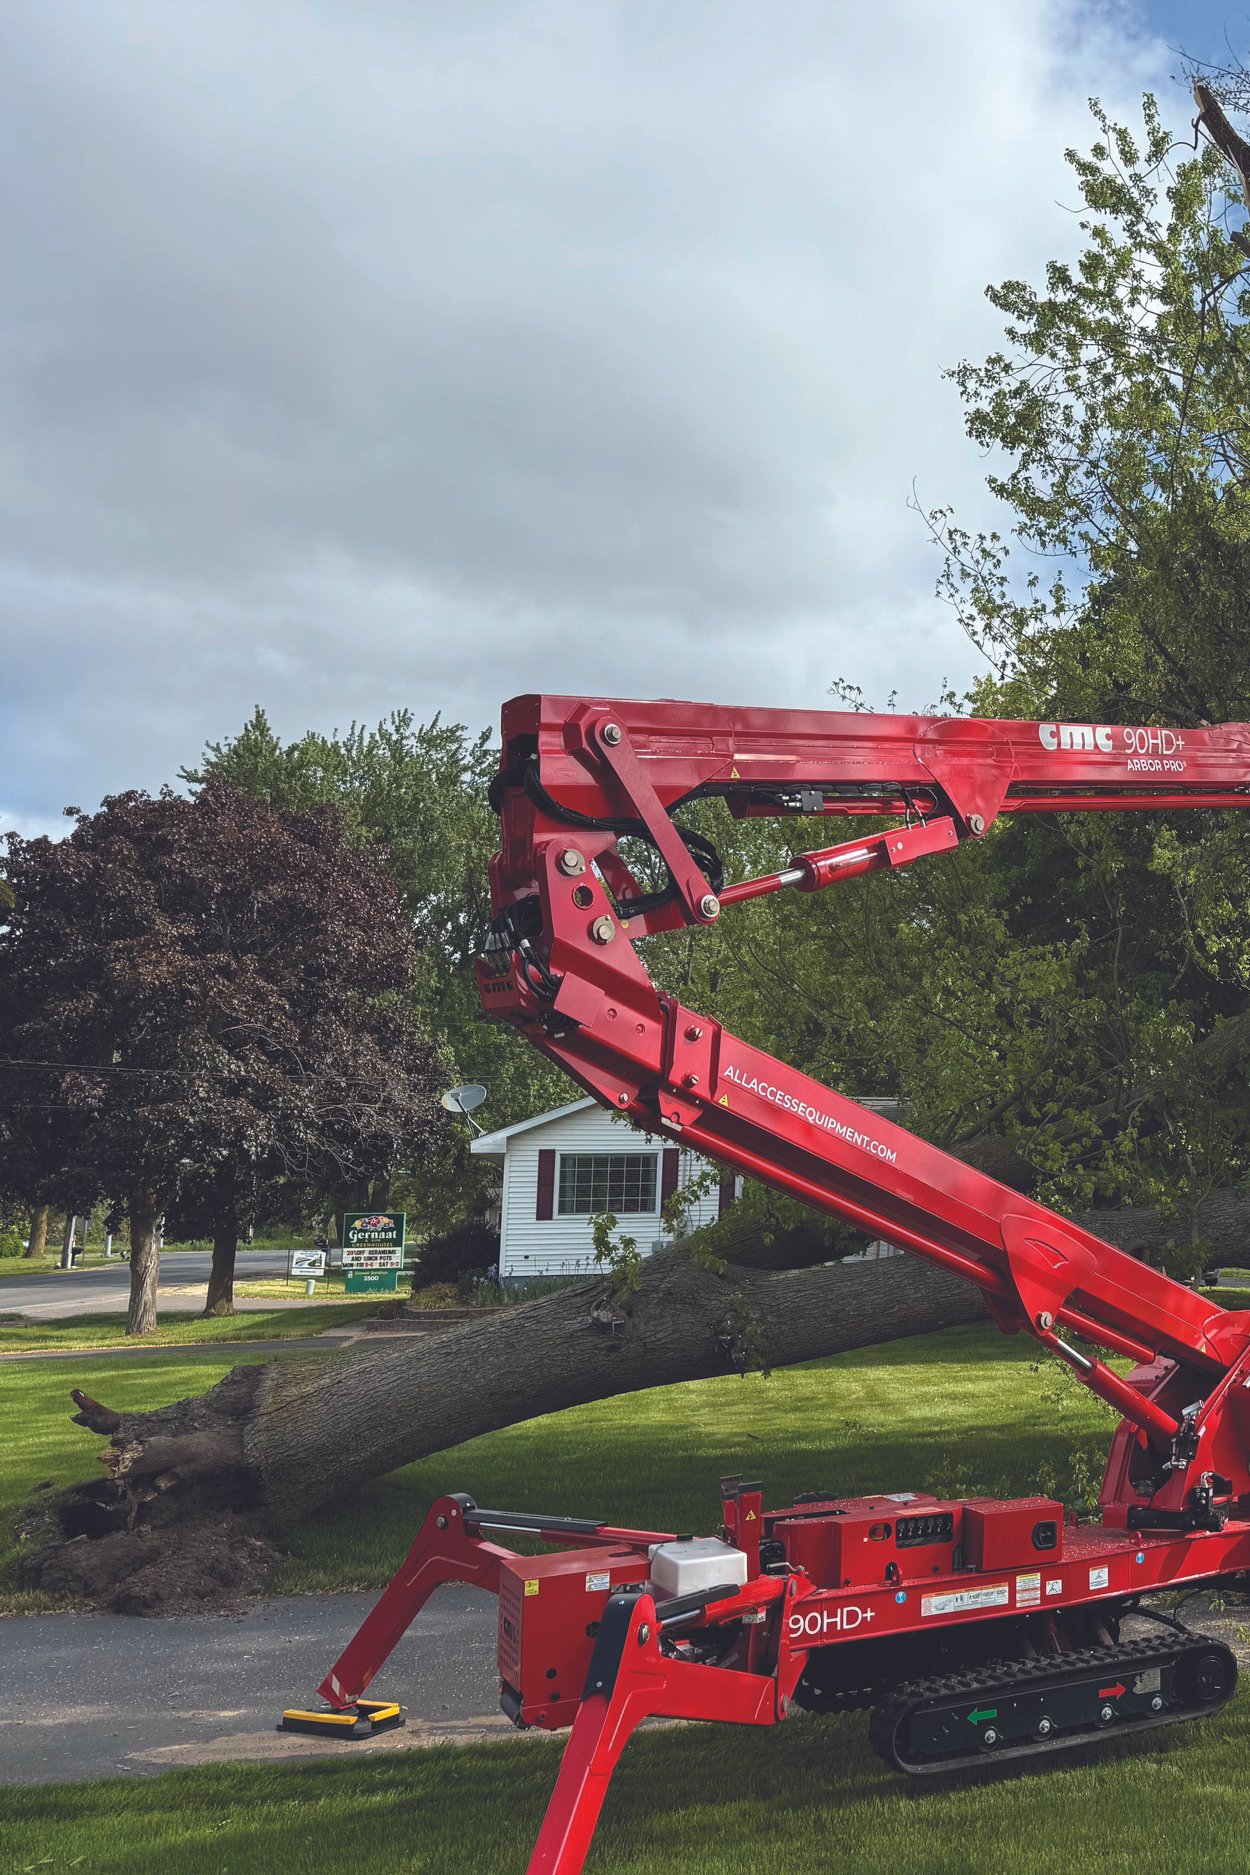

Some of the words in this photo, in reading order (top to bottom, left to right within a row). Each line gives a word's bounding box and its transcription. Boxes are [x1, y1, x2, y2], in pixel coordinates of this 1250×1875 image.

[1039, 724, 1112, 752] cmc
[1123, 728, 1185, 754] 90HD+
[1127, 759, 1162, 772] ARBOR
[724, 1066, 896, 1164] ALLACCESSEQUIPMENT.COM
[348, 1230, 397, 1243] Gernaat
[788, 1606, 876, 1638] 90HD+
